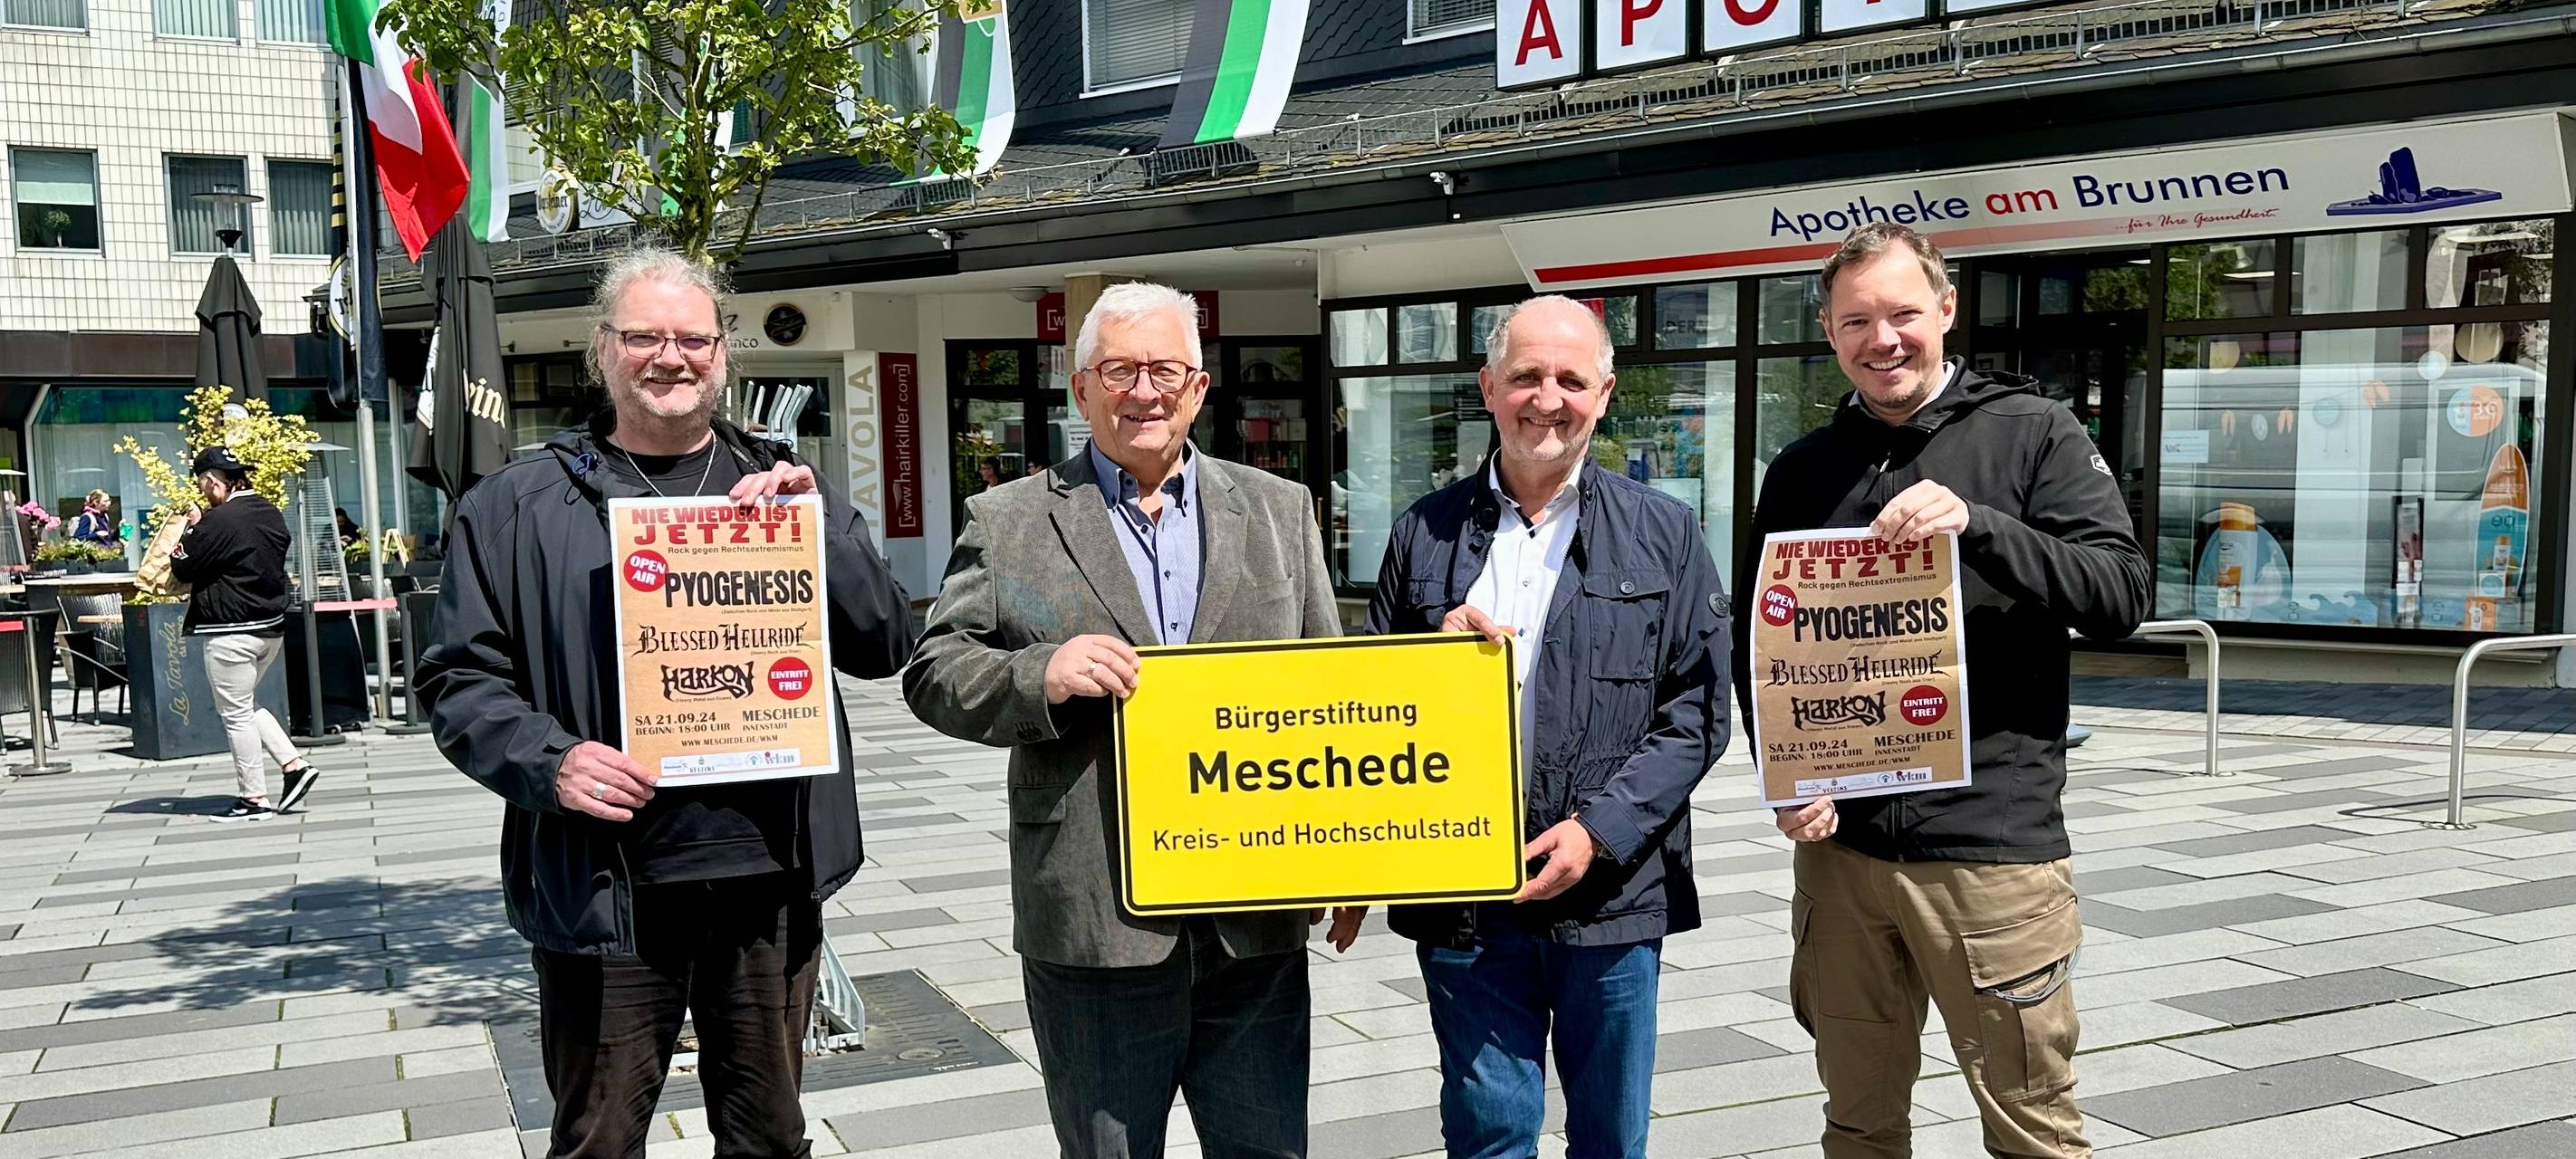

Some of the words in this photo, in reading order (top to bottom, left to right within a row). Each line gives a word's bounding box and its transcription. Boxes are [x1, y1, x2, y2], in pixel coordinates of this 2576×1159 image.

[1770, 189, 1970, 242] Apotheke
[1985, 187, 2059, 216] am
[2072, 167, 2290, 207] Brunnen
[631, 506, 668, 524] NIE
[673, 505, 761, 523] WIEDER
[765, 505, 801, 522] IST
[634, 522, 802, 545] JETZT!
[668, 546, 690, 554] Rock
[692, 546, 719, 555] gegen
[721, 545, 804, 553] Rechtsextremismus
[1775, 542, 1803, 559] NIE
[1808, 537, 1890, 559] WIEDER
[630, 555, 667, 574] OPEN
[1773, 551, 1934, 580] JETZT!
[631, 571, 656, 585] AIR
[1798, 580, 1818, 589] Rock
[1820, 582, 1846, 590] gegen
[1849, 573, 1937, 588] Rechtsextremismus
[665, 569, 813, 608] PYOGENESIS
[1766, 590, 1795, 608] OPEN
[1766, 605, 1786, 619] AIR
[1793, 597, 1948, 642] PYOGENESIS
[159, 622, 183, 689] Tavola
[771, 669, 809, 679] EINTRITT
[778, 681, 803, 692] FREI
[168, 691, 189, 725] La
[1903, 696, 1944, 707] EINTRITT
[635, 715, 651, 725] SA
[656, 712, 716, 725] 21.09.24
[742, 706, 821, 722] MESCHEDE
[1215, 701, 1418, 733] Bürgerstiftung
[1912, 708, 1937, 718] FREI
[635, 726, 675, 735] BEGINN:
[678, 724, 707, 733] 18:00
[710, 723, 731, 732] UHR
[743, 723, 788, 732] INNENSTADT
[1768, 743, 1784, 753] SA
[1788, 739, 1849, 752] 21.09.24
[1874, 730, 1956, 747] MESCHEDE
[1811, 751, 1840, 760] 18:00
[1842, 748, 1862, 757] UHR
[1874, 745, 1920, 755] INNENSTADT
[1188, 742, 1450, 794] Meschede
[1153, 829, 1230, 851] Kreis-
[1239, 824, 1285, 848] und
[1294, 815, 1492, 846] Hochschulstadt
